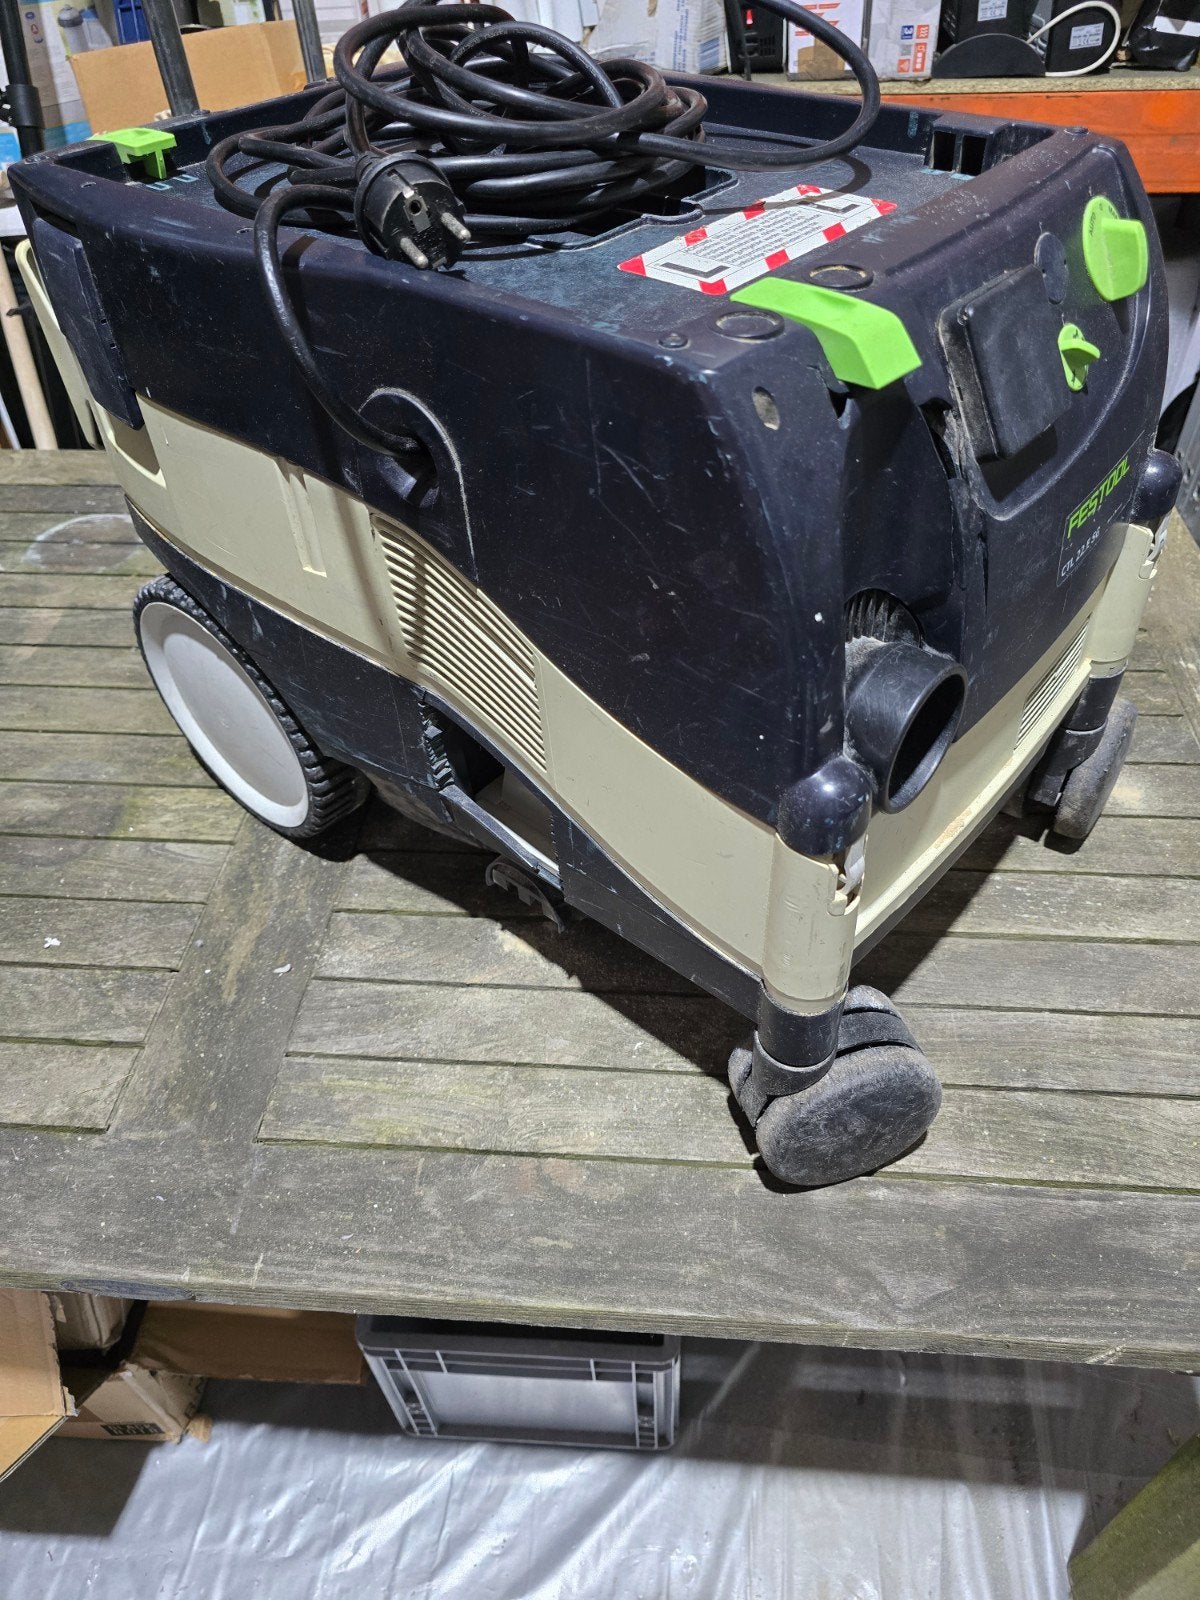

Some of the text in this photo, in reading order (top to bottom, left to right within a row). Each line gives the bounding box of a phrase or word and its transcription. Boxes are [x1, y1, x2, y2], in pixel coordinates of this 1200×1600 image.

[1066, 455, 1130, 539] FESTOOL
[1061, 557, 1074, 577] CTL
[1075, 544, 1086, 562] 22
